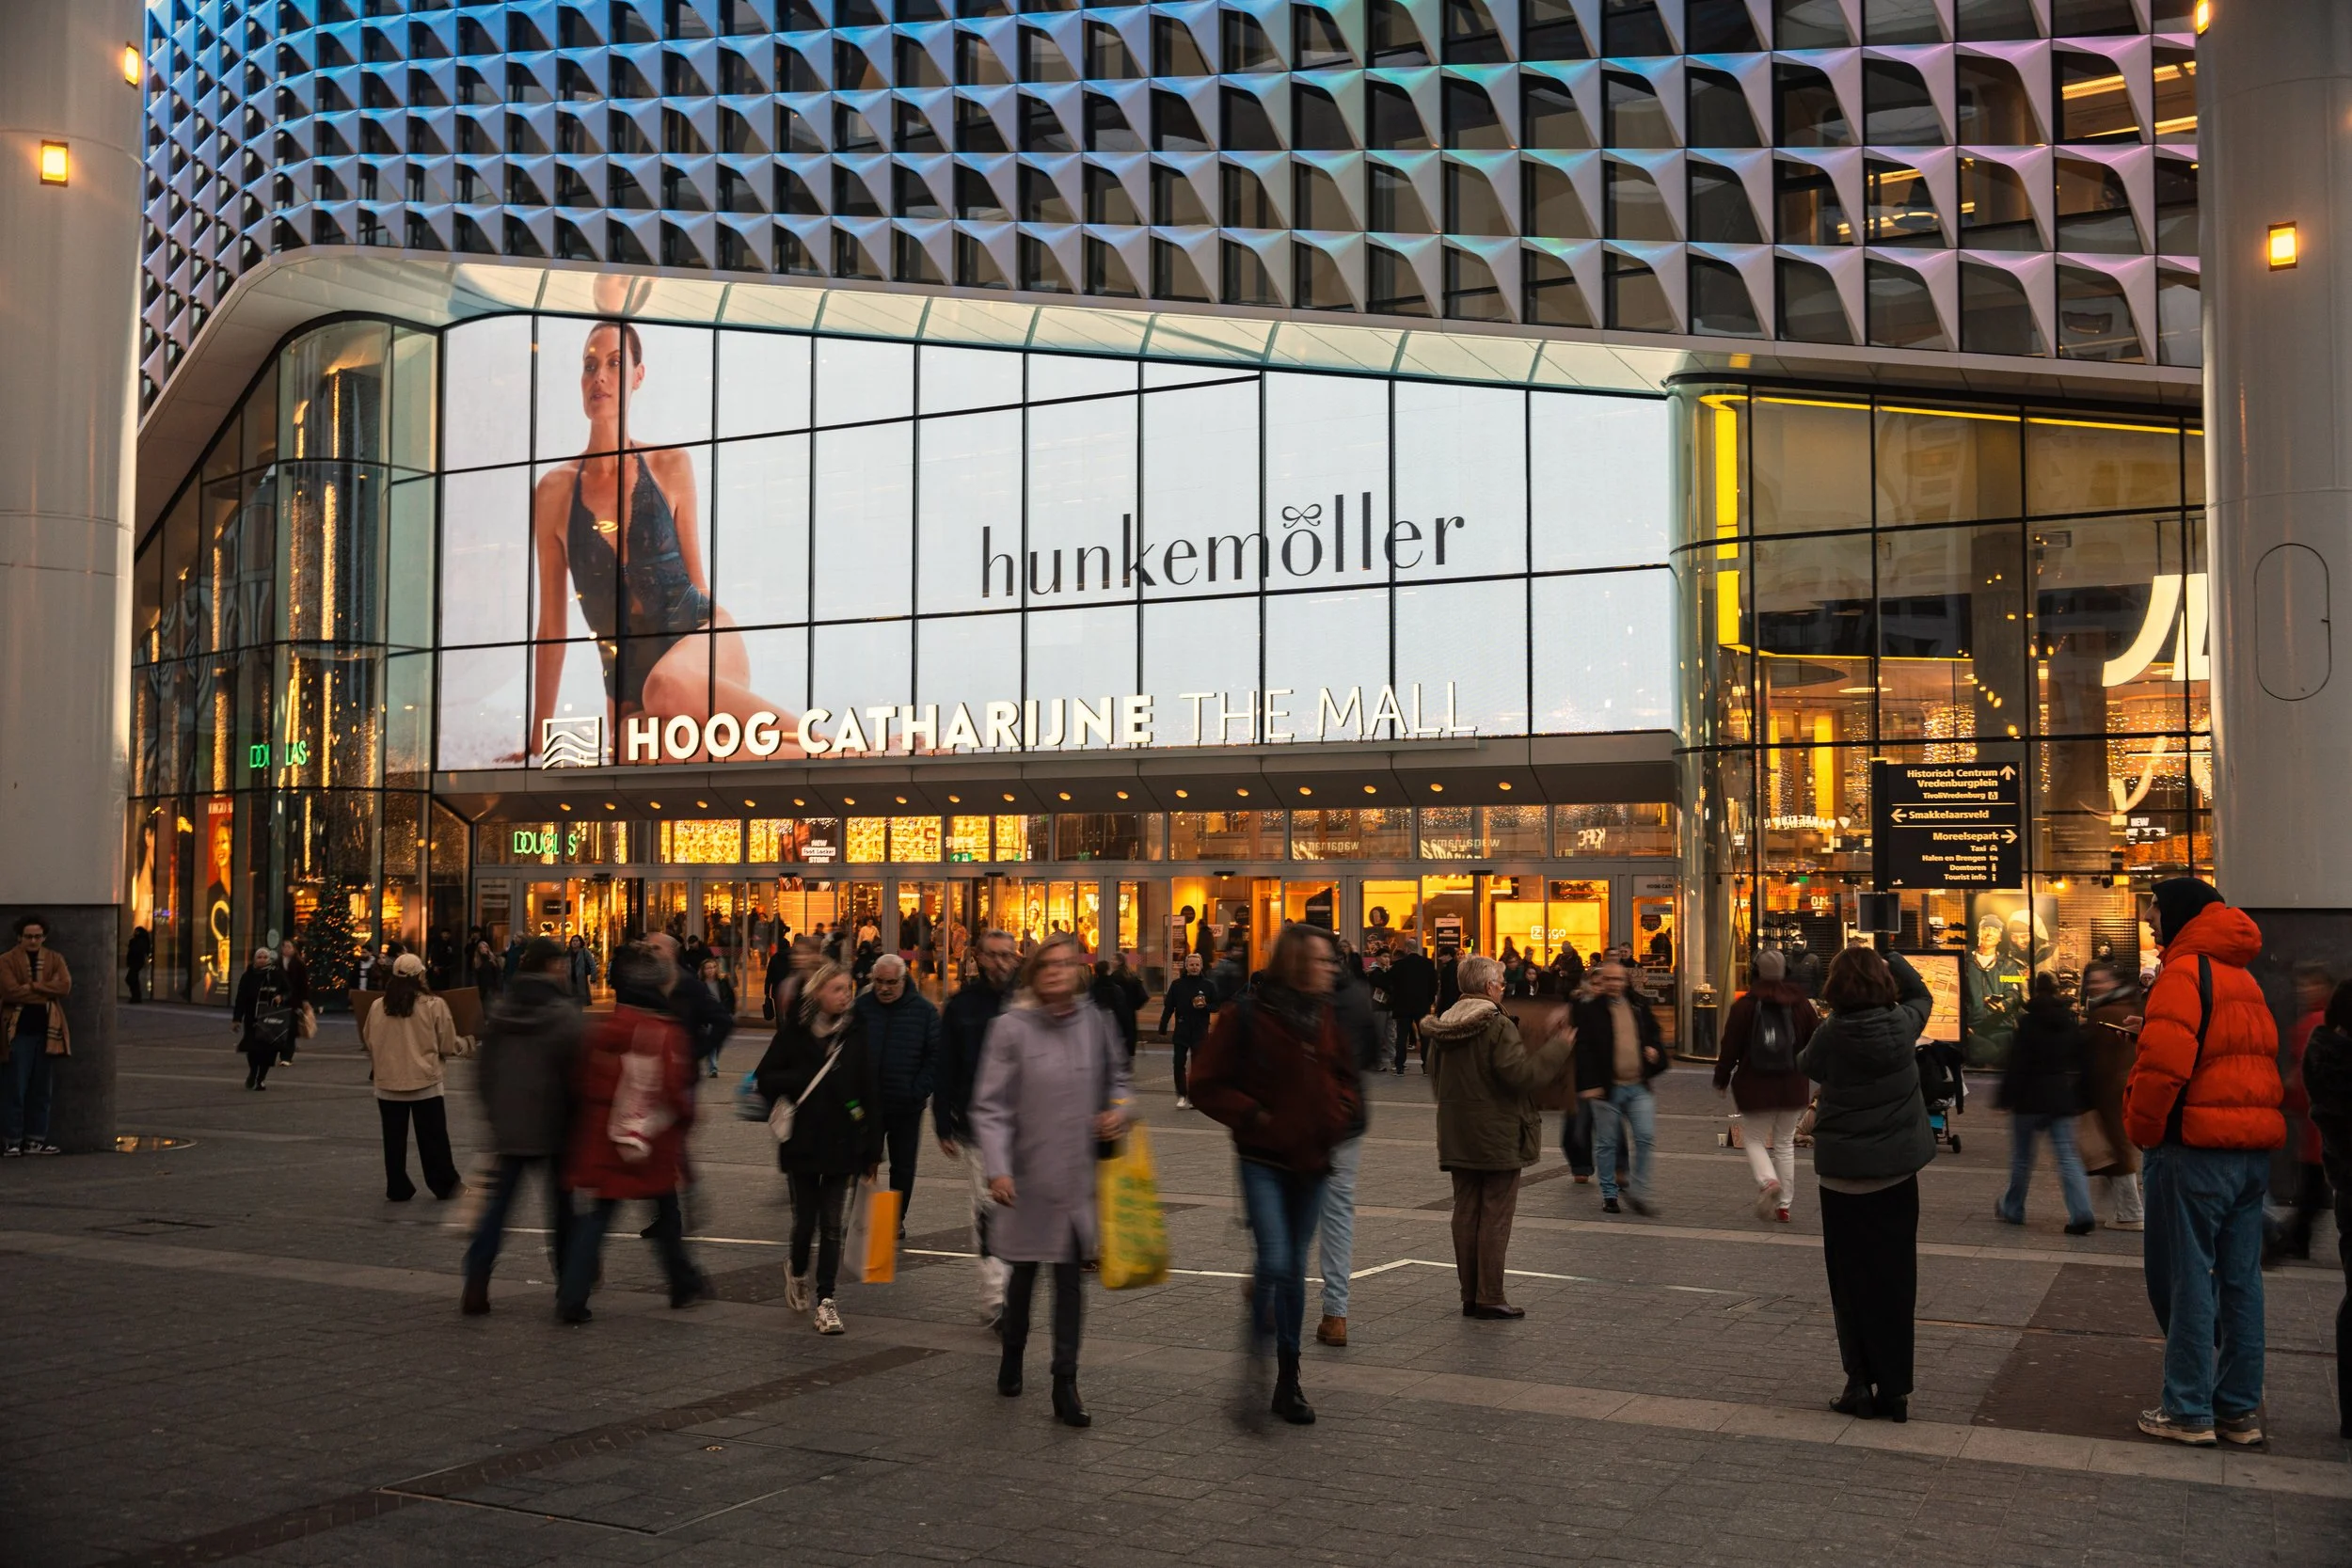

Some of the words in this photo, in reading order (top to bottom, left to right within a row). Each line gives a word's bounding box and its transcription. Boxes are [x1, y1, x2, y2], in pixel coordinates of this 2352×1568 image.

[628, 712, 785, 761] HOOG
[796, 694, 1154, 755] CATHARIJNE
[1179, 688, 1295, 742] THE
[1317, 681, 1478, 737] MALL
[1907, 769, 1954, 778] Historisch
[1956, 769, 1998, 778] Centrum
[1917, 779, 1998, 788] Vredenburgplein
[1909, 810, 1990, 819] Smakkelaarsveld
[1932, 832, 1999, 842] Moreelsepark
[514, 831, 577, 856] DOUGLS
